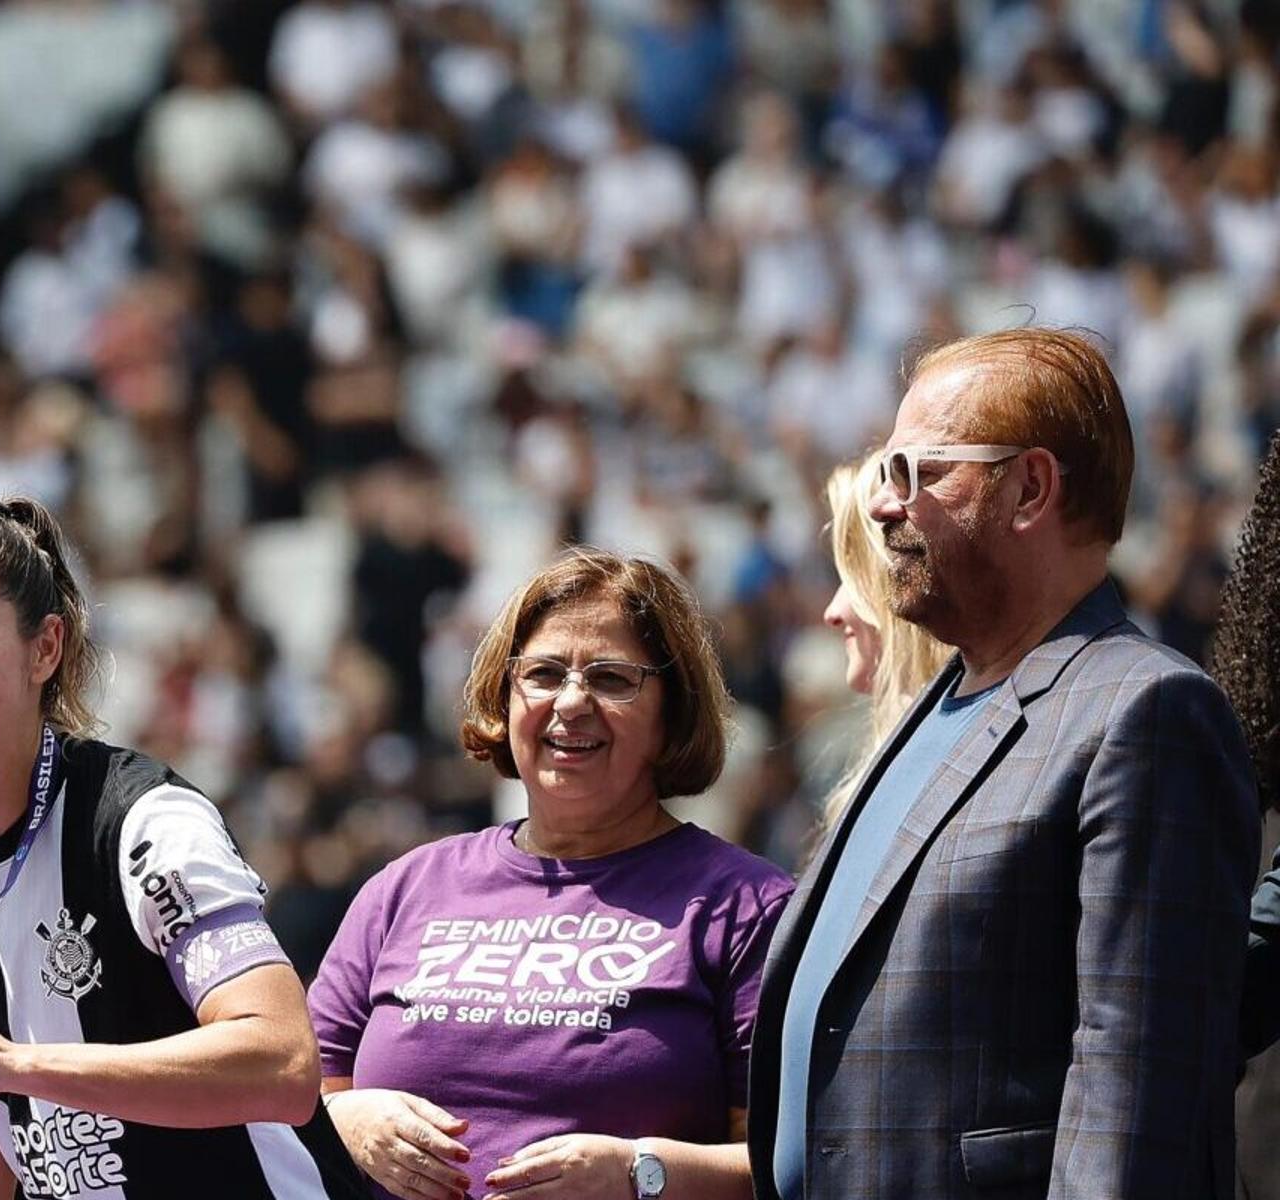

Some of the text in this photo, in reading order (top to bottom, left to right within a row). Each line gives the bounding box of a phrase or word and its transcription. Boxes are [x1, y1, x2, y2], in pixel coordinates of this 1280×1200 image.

[421, 912, 662, 945] FEMINICÍDIO
[406, 941, 676, 990] ZERO
[514, 986, 631, 1010] violência
[454, 1003, 501, 1025] ser
[503, 1005, 613, 1031] tolerada
